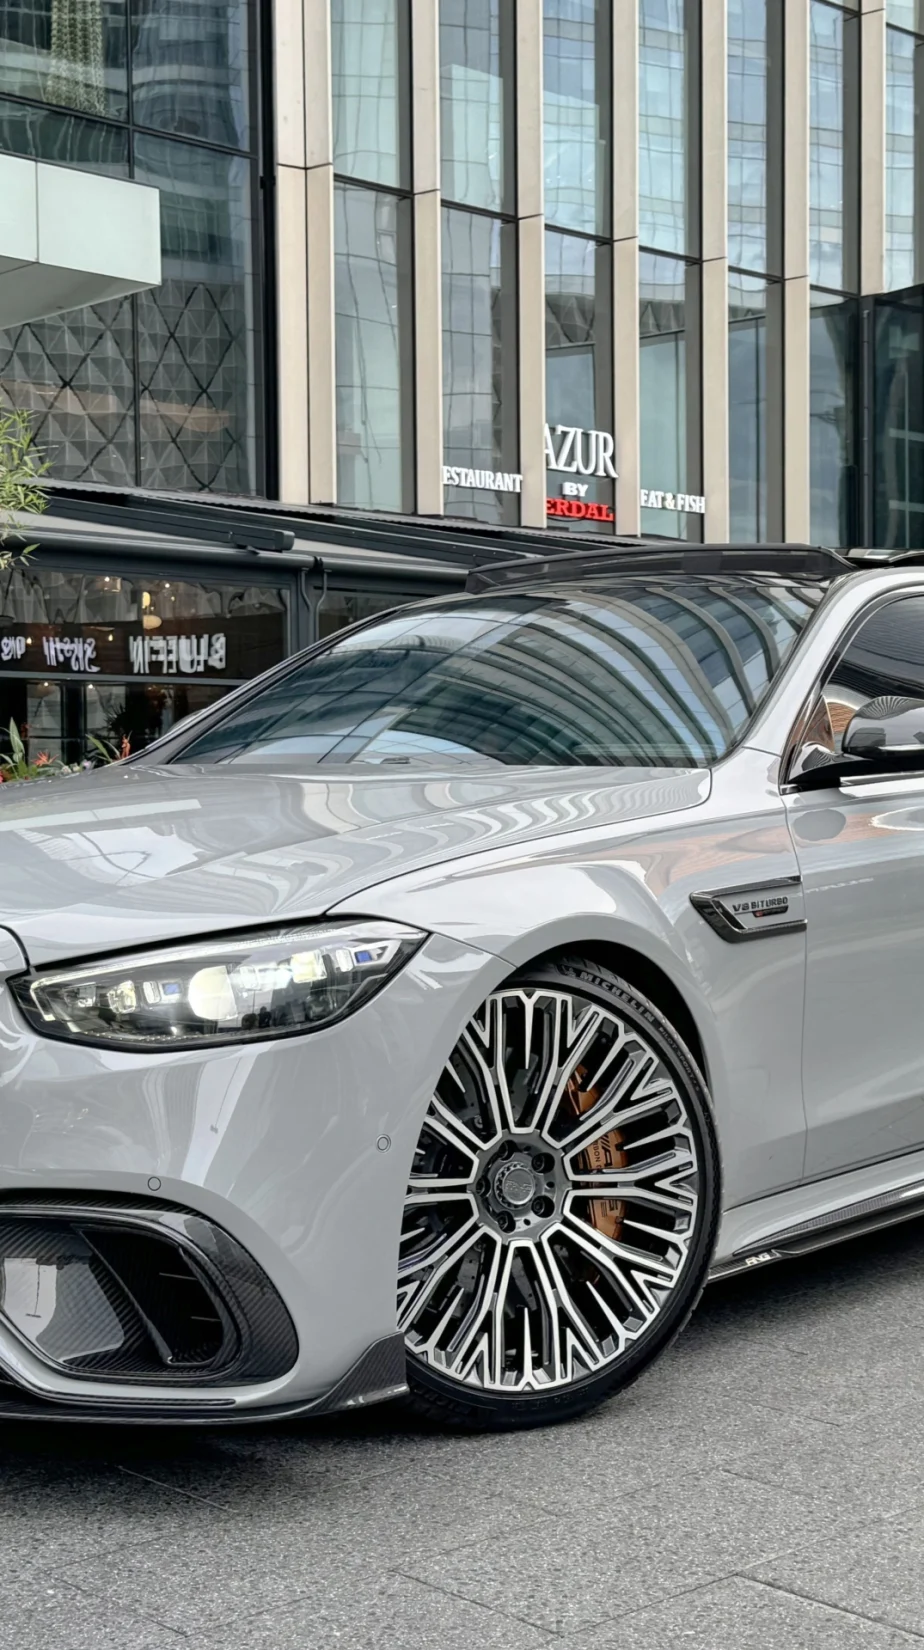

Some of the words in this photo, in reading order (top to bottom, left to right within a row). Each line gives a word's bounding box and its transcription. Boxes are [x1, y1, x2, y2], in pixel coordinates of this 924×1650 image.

[544, 423, 619, 478] AZUR
[442, 466, 522, 492] ESTAURANT
[562, 482, 588, 497] BY
[546, 497, 614, 521] ERDAL
[665, 492, 676, 510] &
[677, 493, 706, 513] FISH
[732, 902, 749, 912] V8
[751, 896, 788, 909] BITURBO
[580, 971, 655, 1022] MICHELIN
